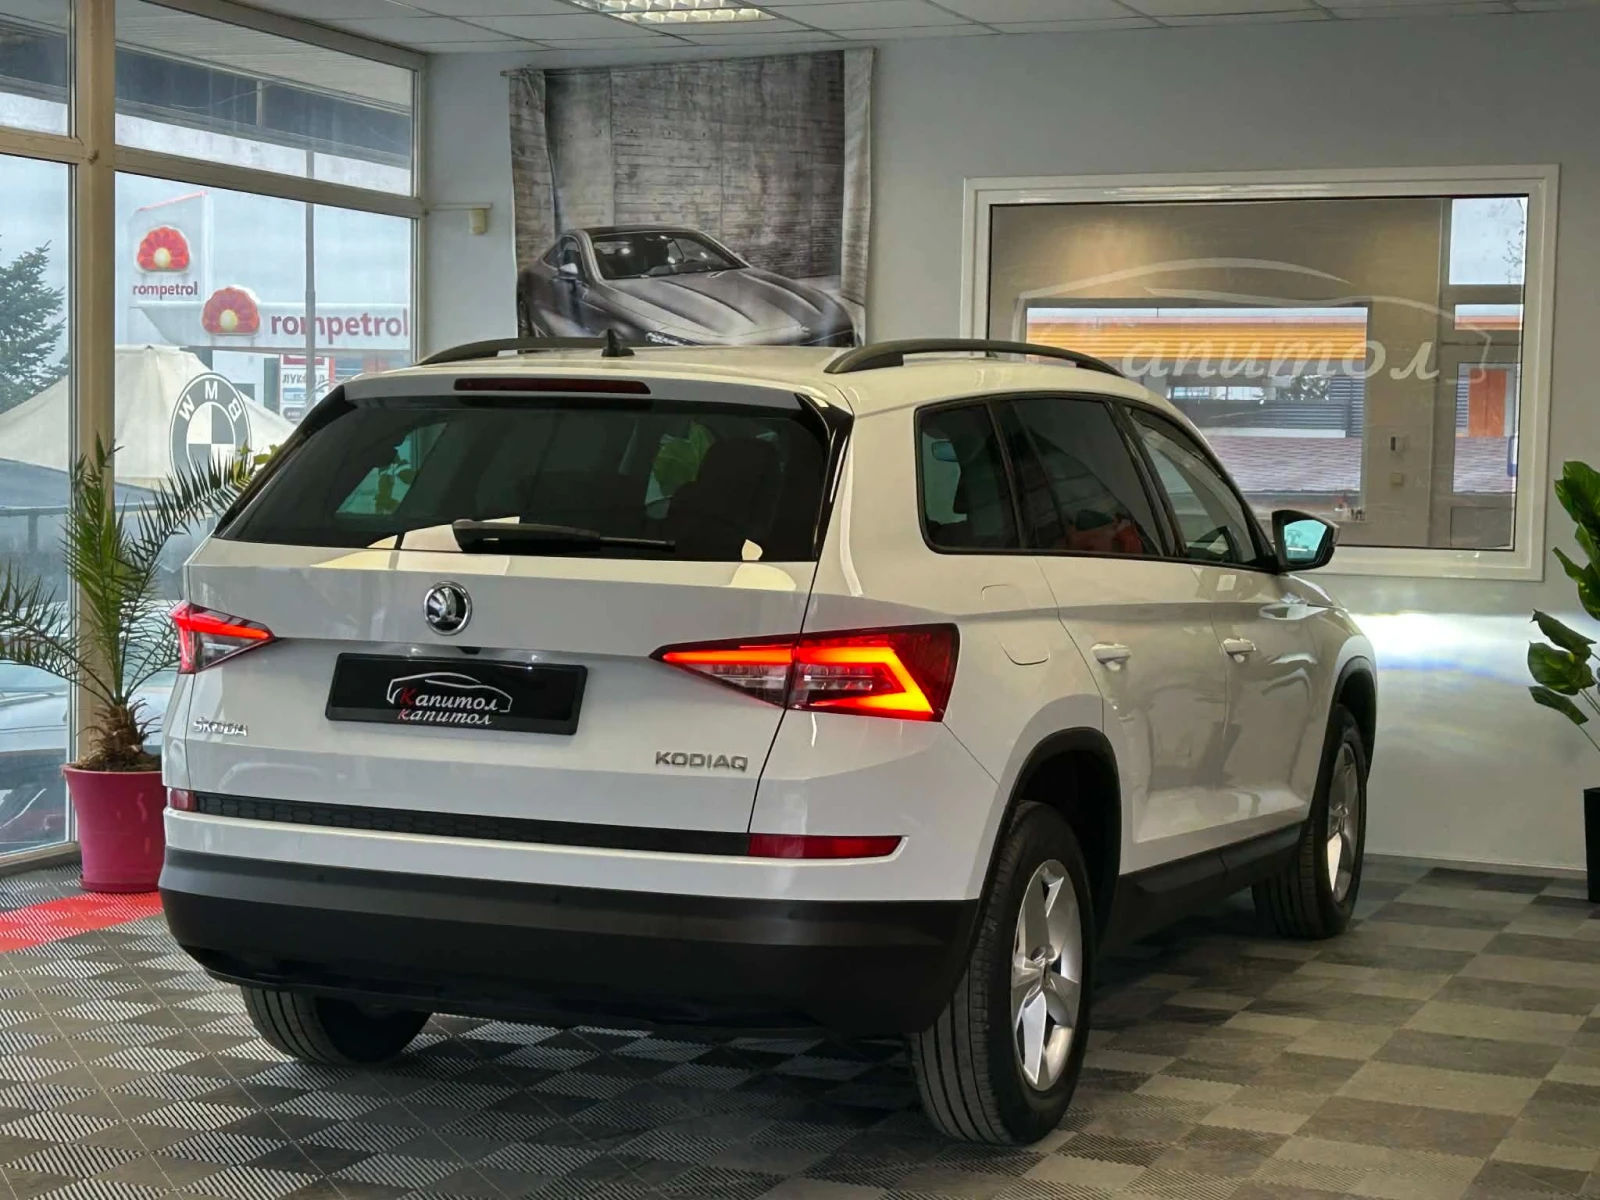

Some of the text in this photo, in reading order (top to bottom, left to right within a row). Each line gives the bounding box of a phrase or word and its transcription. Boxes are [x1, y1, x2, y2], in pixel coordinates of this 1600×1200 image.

[132, 281, 198, 300] rompetrol
[271, 308, 408, 344] rompetrol
[400, 686, 498, 712] Капитол
[655, 751, 749, 773] KODIAQ
